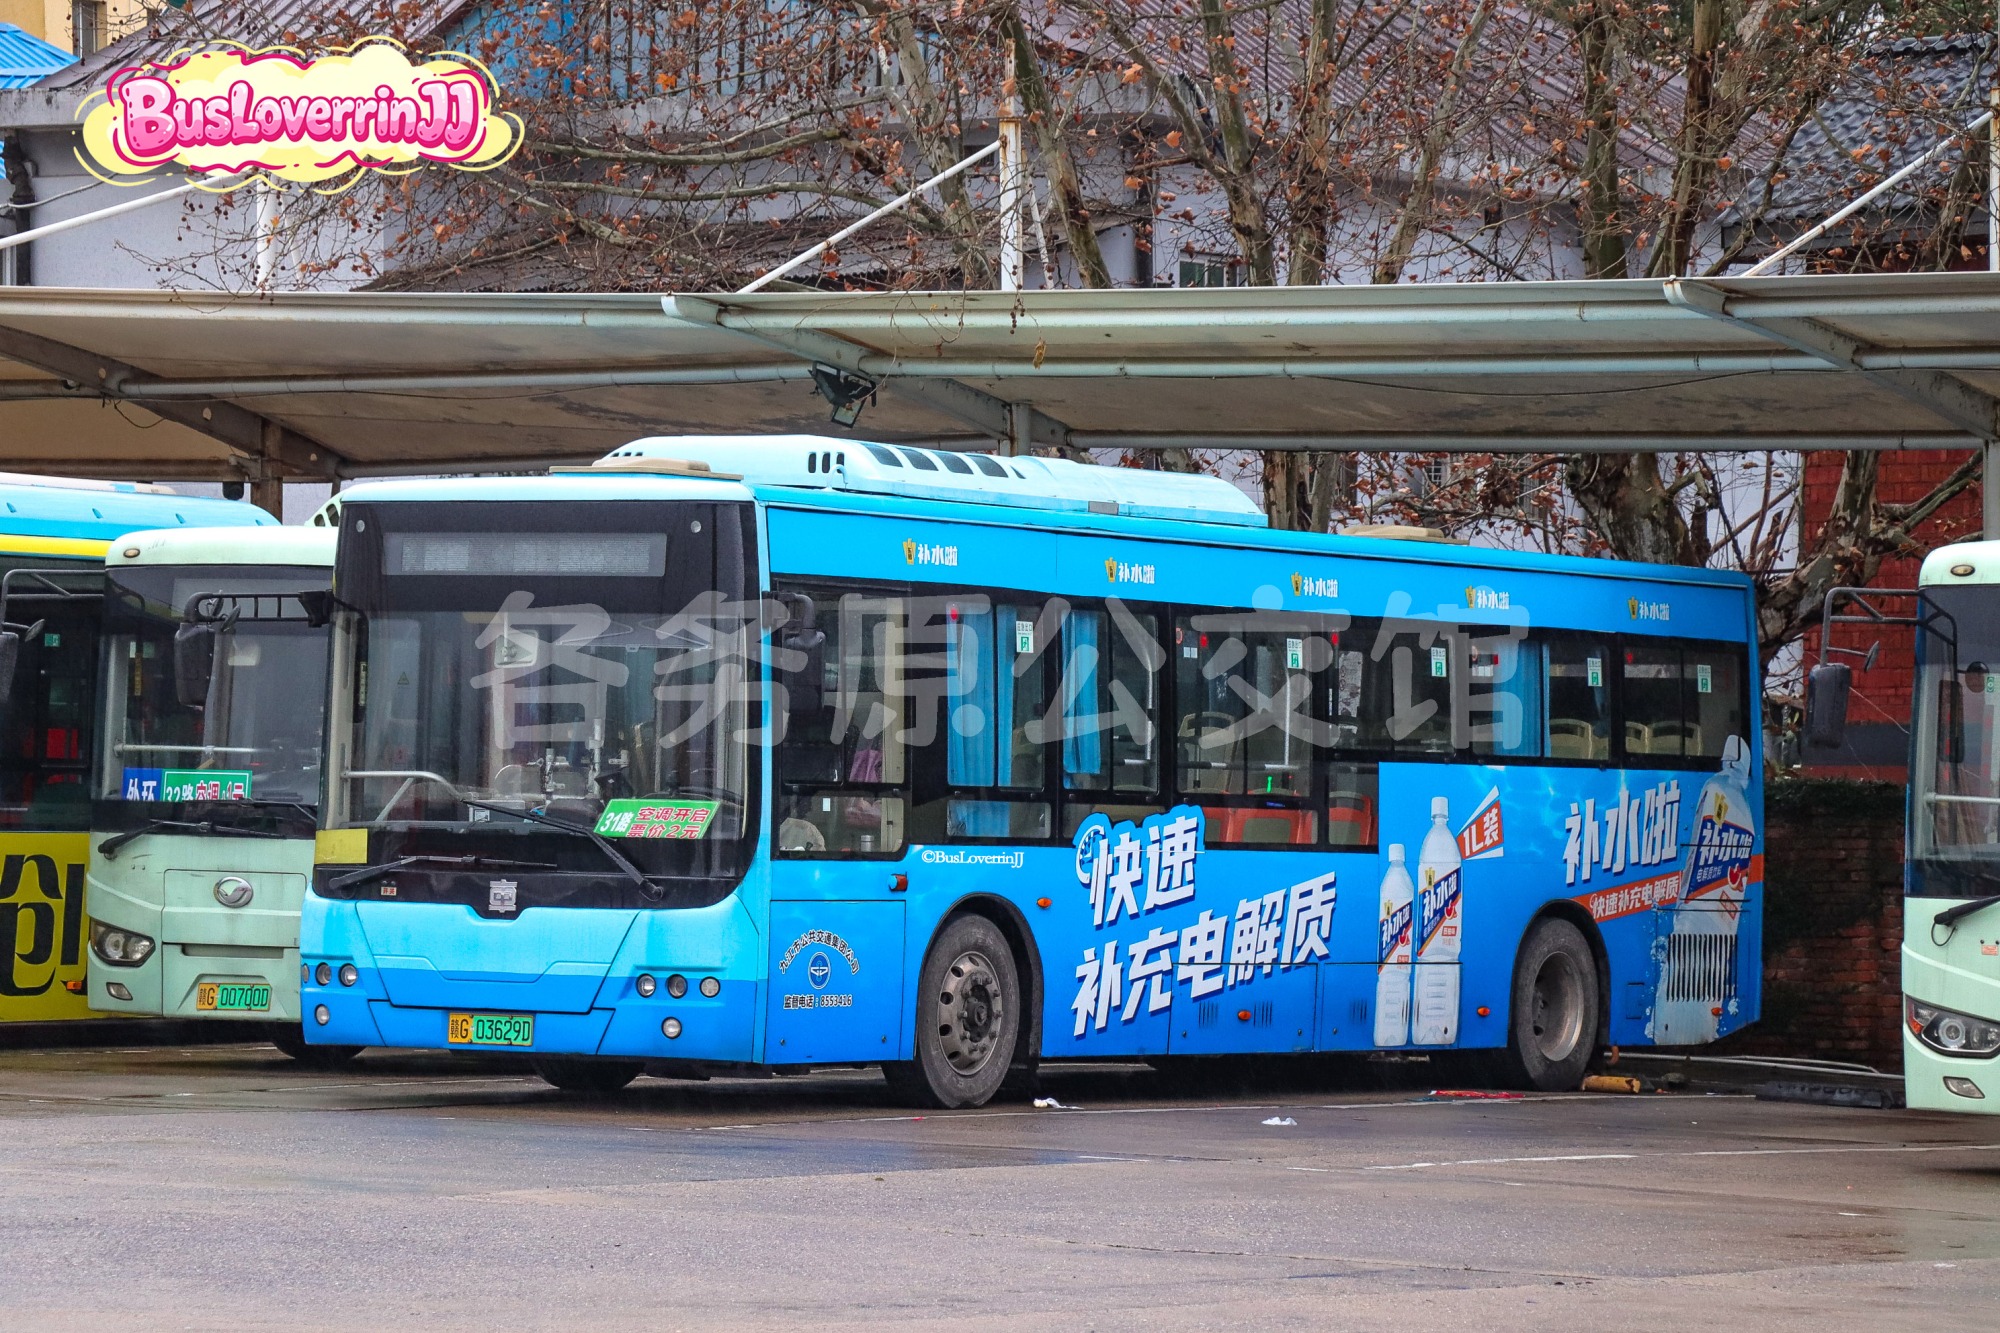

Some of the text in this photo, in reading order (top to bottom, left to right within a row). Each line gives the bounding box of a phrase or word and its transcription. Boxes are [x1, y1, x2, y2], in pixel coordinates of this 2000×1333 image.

[918, 544, 958, 566] 补水啦
[1118, 563, 1155, 584] 补水啦
[1303, 577, 1338, 598] 补水啦
[1477, 591, 1510, 610] 补水啦
[1639, 602, 1670, 621] 补水啦
[600, 812, 634, 832] 31路
[627, 823, 701, 839] 票价2元
[636, 807, 710, 823] 空调开启
[1463, 807, 1498, 857] 1L装
[1563, 780, 1680, 884] 补水啦
[1699, 822, 1753, 866] 补水啦
[1088, 816, 1198, 926] 快速
[1423, 872, 1457, 927] 补水啦
[1592, 875, 1680, 919] 快速补充电解质
[1382, 904, 1410, 948] 补水啦
[779, 929, 859, 974] 九江市公共交通集团公司
[1071, 871, 1336, 1036] 补充电解质
